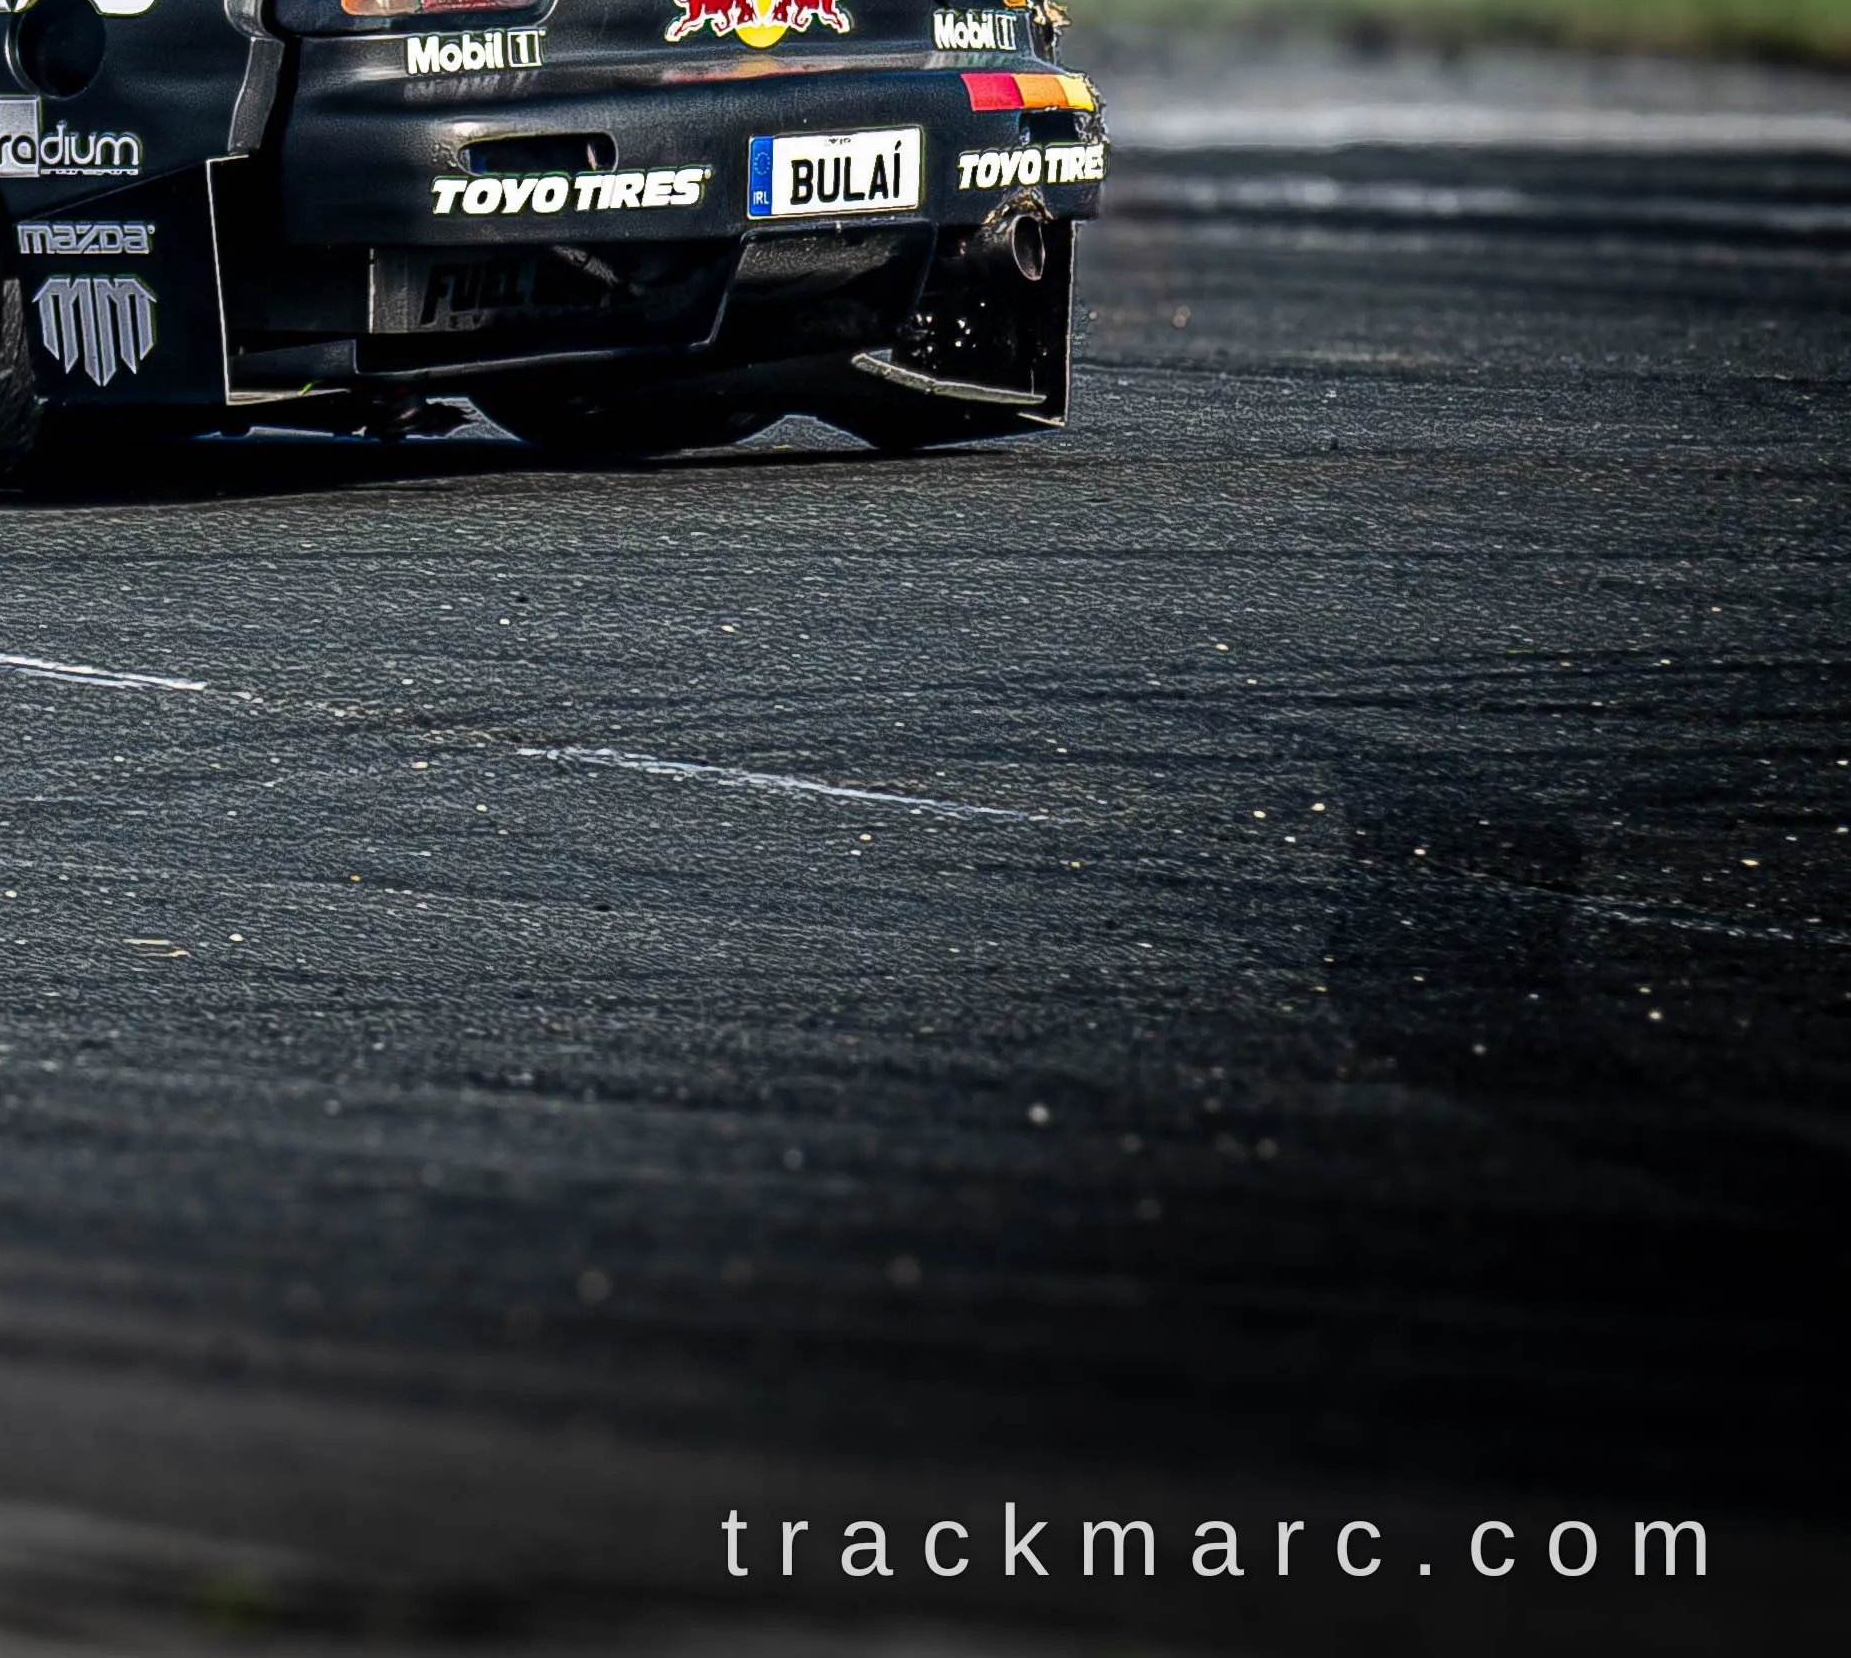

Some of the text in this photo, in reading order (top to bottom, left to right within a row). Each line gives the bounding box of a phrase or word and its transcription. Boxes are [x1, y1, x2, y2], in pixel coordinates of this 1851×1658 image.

[407, 31, 505, 75] Mobil
[933, 12, 997, 50] Mobil
[790, 140, 902, 205] BULAÍ
[958, 142, 1104, 190] TOYO TIRE
[431, 167, 703, 214] TOYO TIRES
[753, 190, 770, 206] IRL
